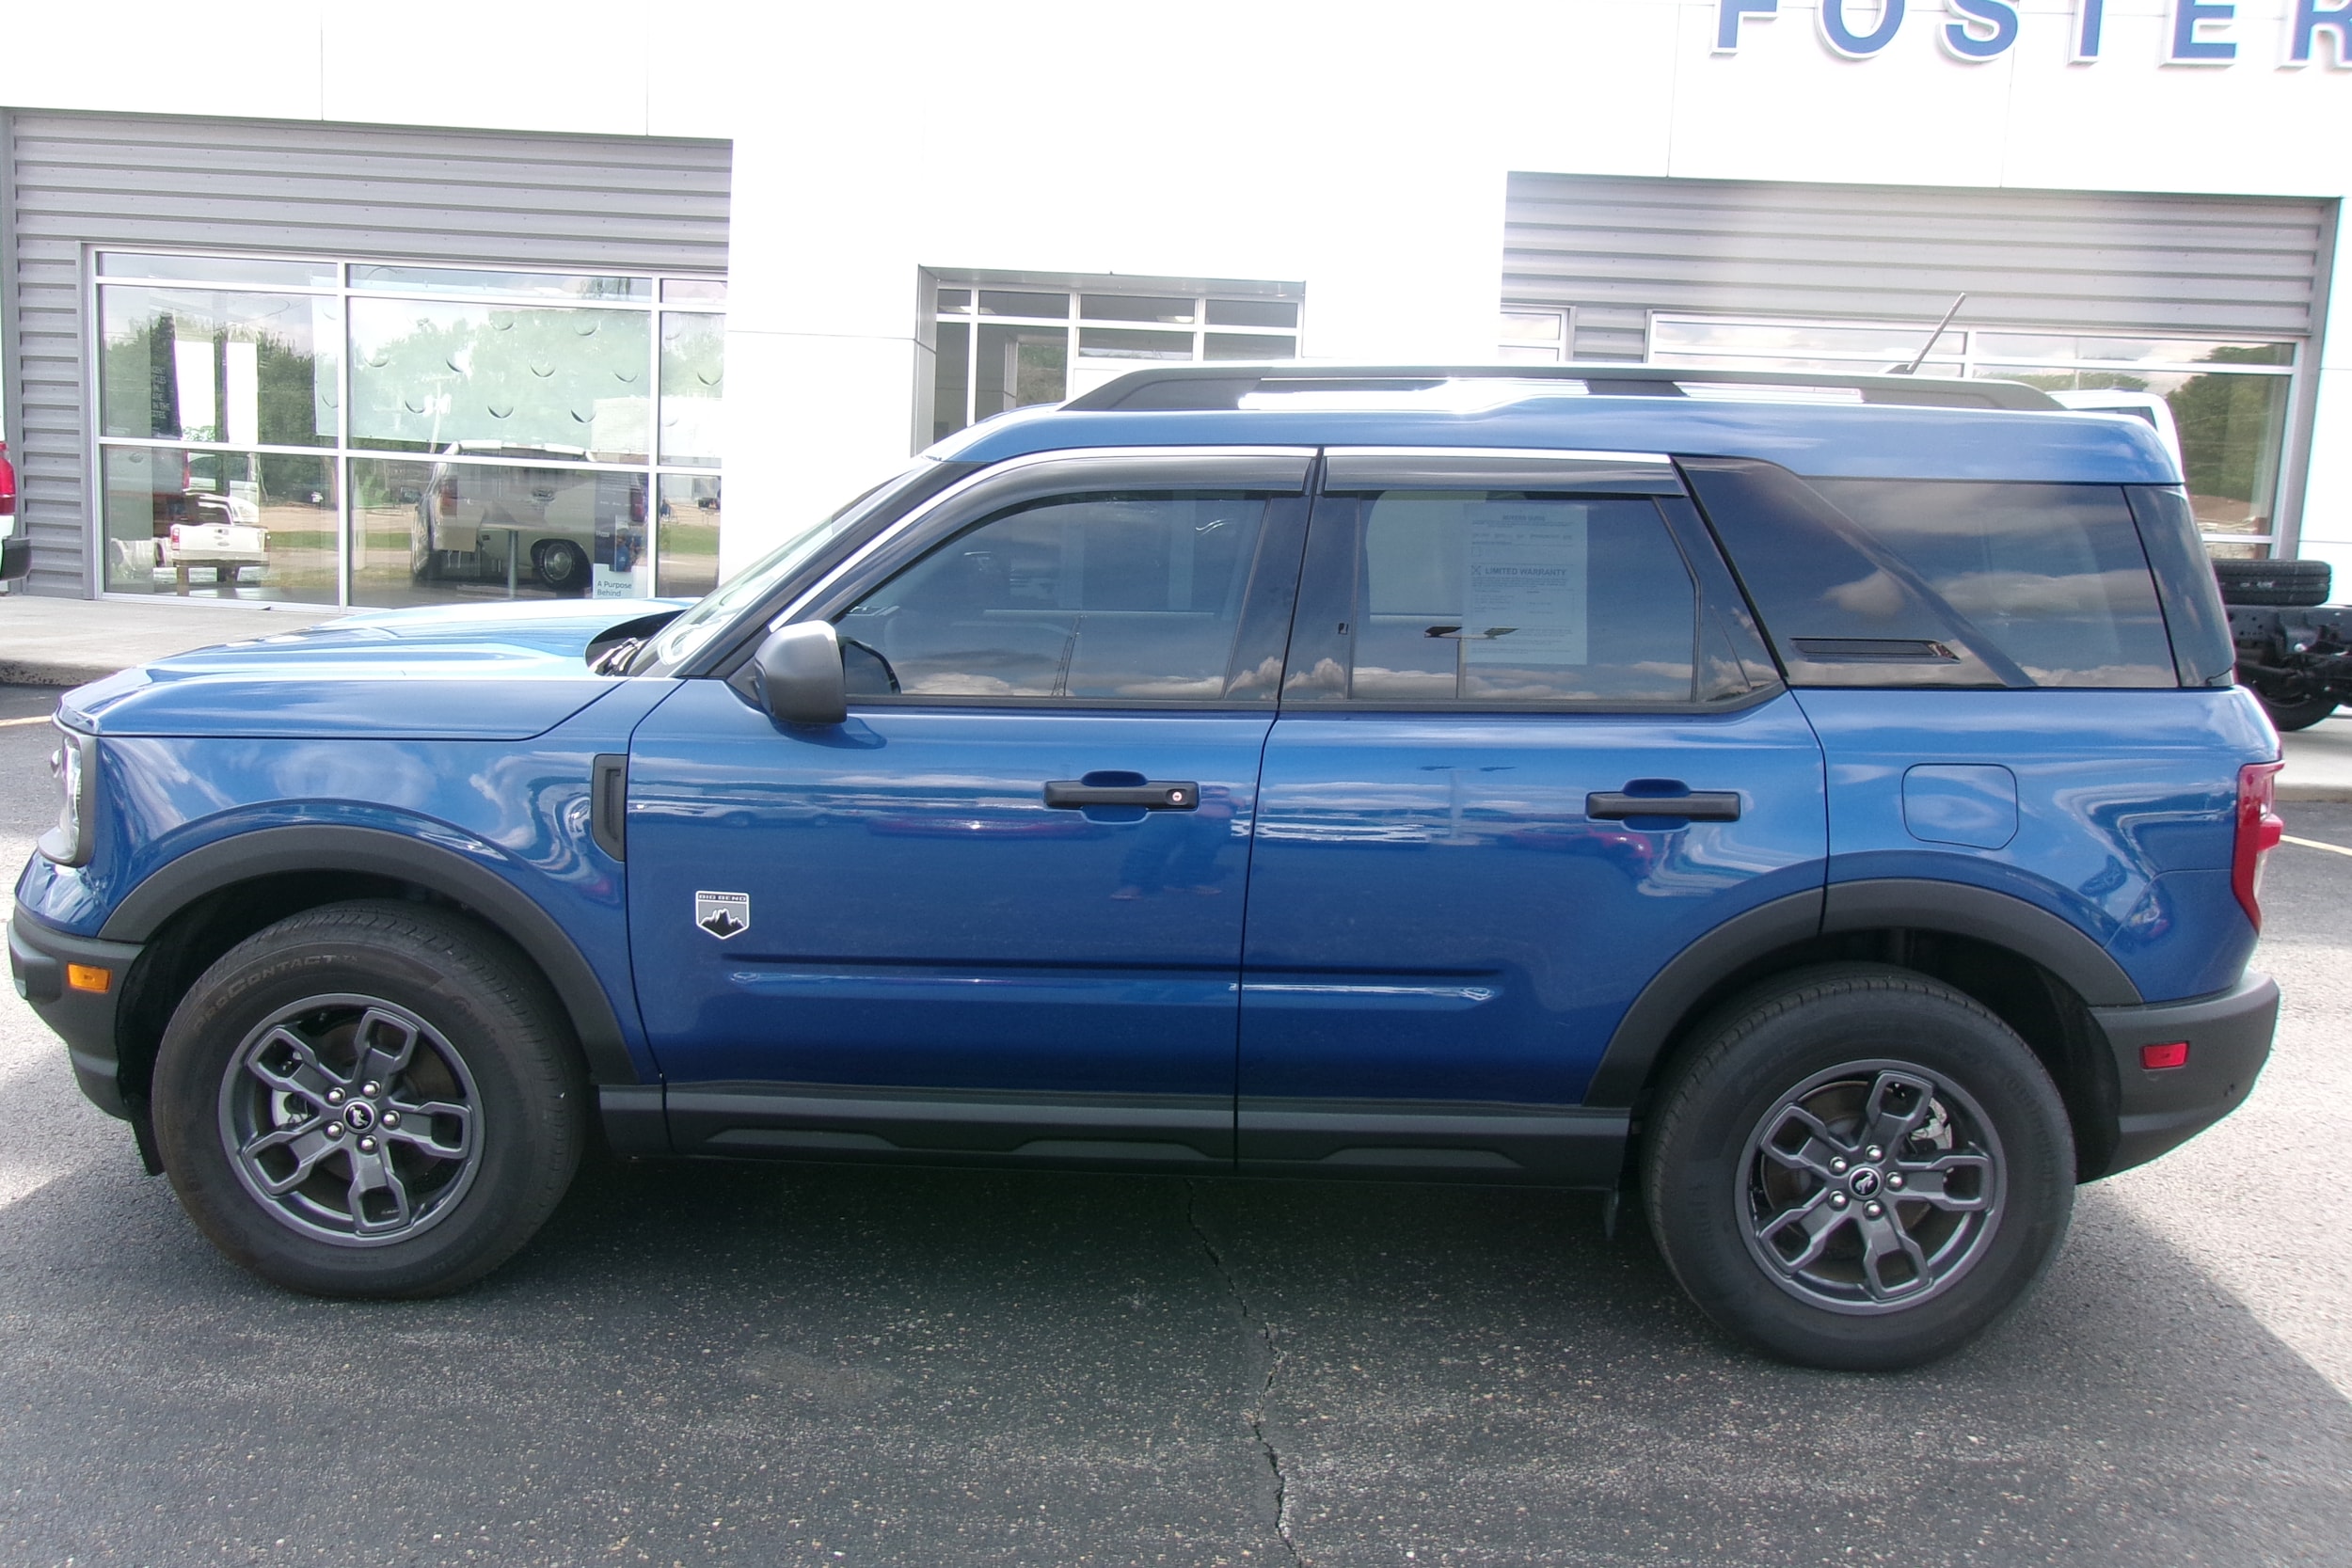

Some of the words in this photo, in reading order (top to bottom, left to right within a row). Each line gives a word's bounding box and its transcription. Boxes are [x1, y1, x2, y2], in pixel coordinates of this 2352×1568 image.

[1485, 567, 1518, 576] LIMITED
[1519, 567, 1566, 577] WARRANTY
[604, 580, 632, 590] Purpose
